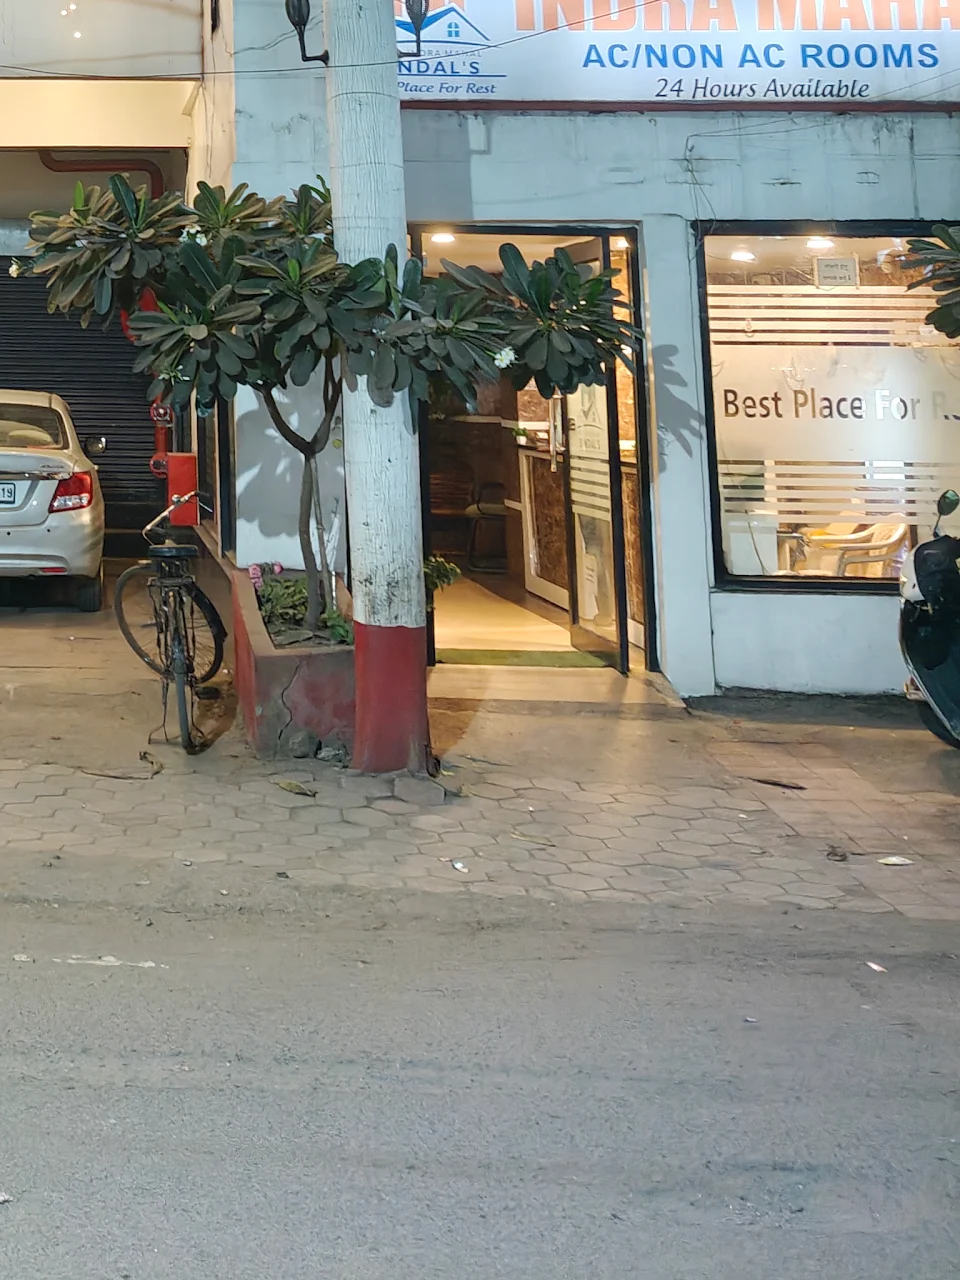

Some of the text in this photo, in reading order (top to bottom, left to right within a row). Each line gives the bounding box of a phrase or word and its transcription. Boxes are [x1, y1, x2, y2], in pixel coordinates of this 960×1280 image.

[582, 43, 939, 68] AC/NON AC ROOMS
[439, 83, 462, 94] For
[466, 83, 497, 94] Rest
[655, 78, 871, 99] 24 Hours Available
[723, 388, 783, 419] Best
[793, 387, 866, 419] Place
[874, 389, 920, 420] For
